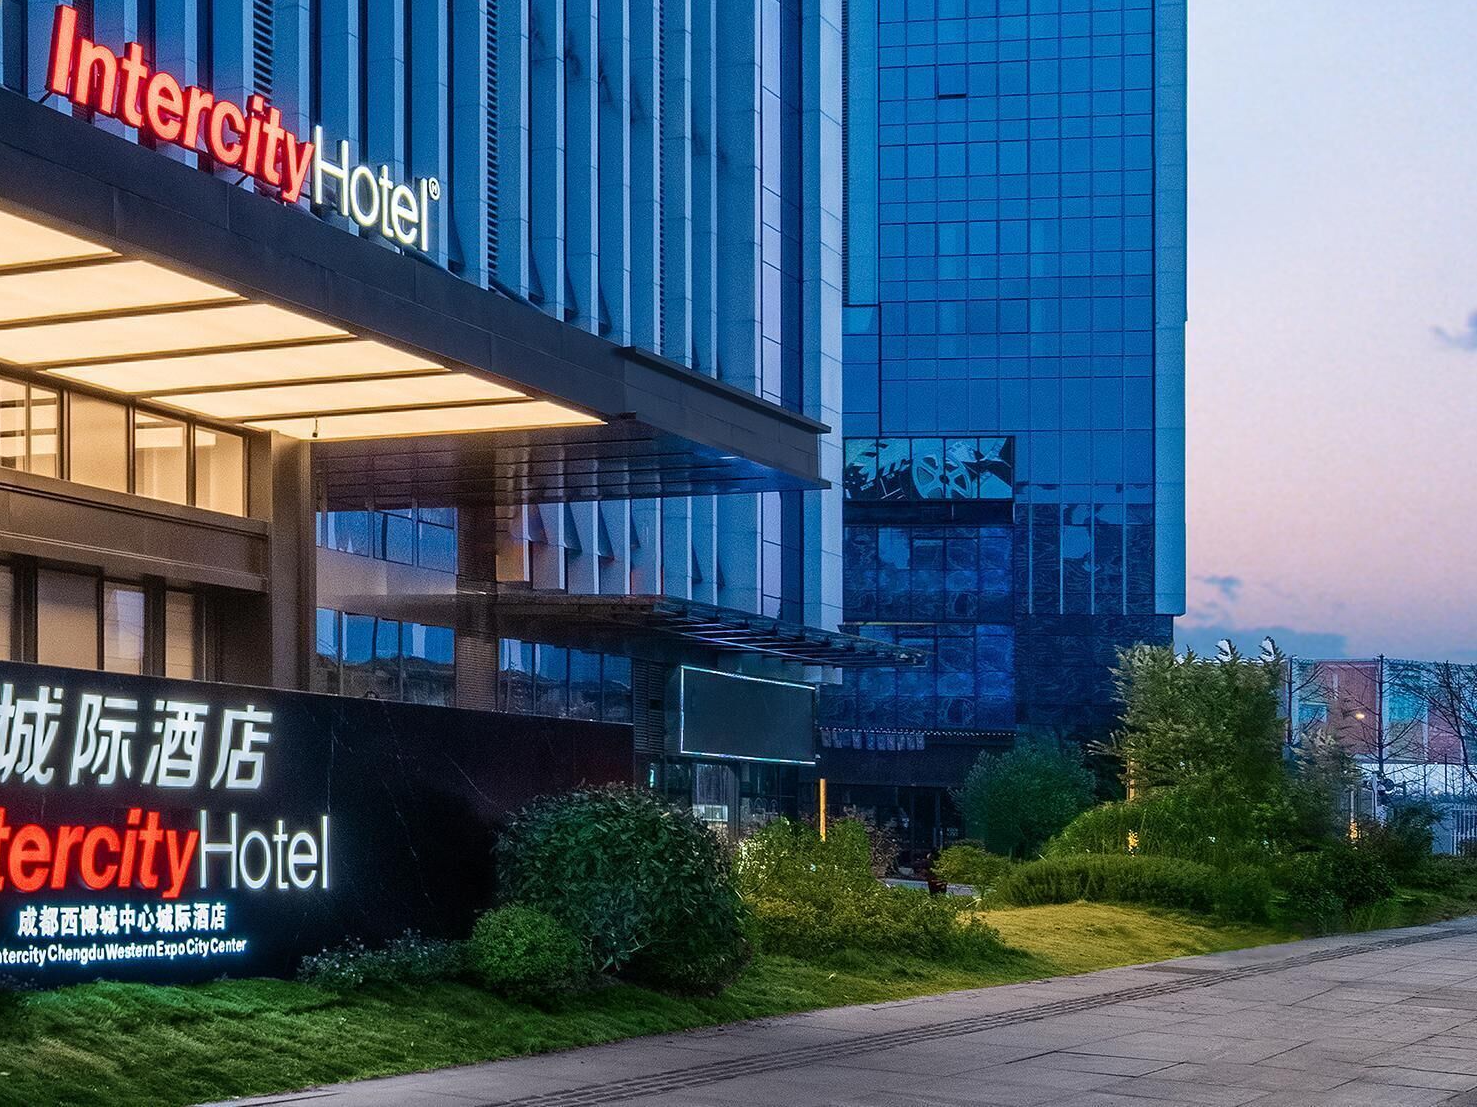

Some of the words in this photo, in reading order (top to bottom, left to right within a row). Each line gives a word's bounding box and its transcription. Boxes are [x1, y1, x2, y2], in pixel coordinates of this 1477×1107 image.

[17, 902, 226, 937] 成都西博城中心城际酒店
[47, 942, 104, 965] Chengdu
[105, 942, 156, 960] Western
[156, 939, 186, 960] Expo
[186, 937, 210, 957] City
[211, 937, 247, 955] Center
